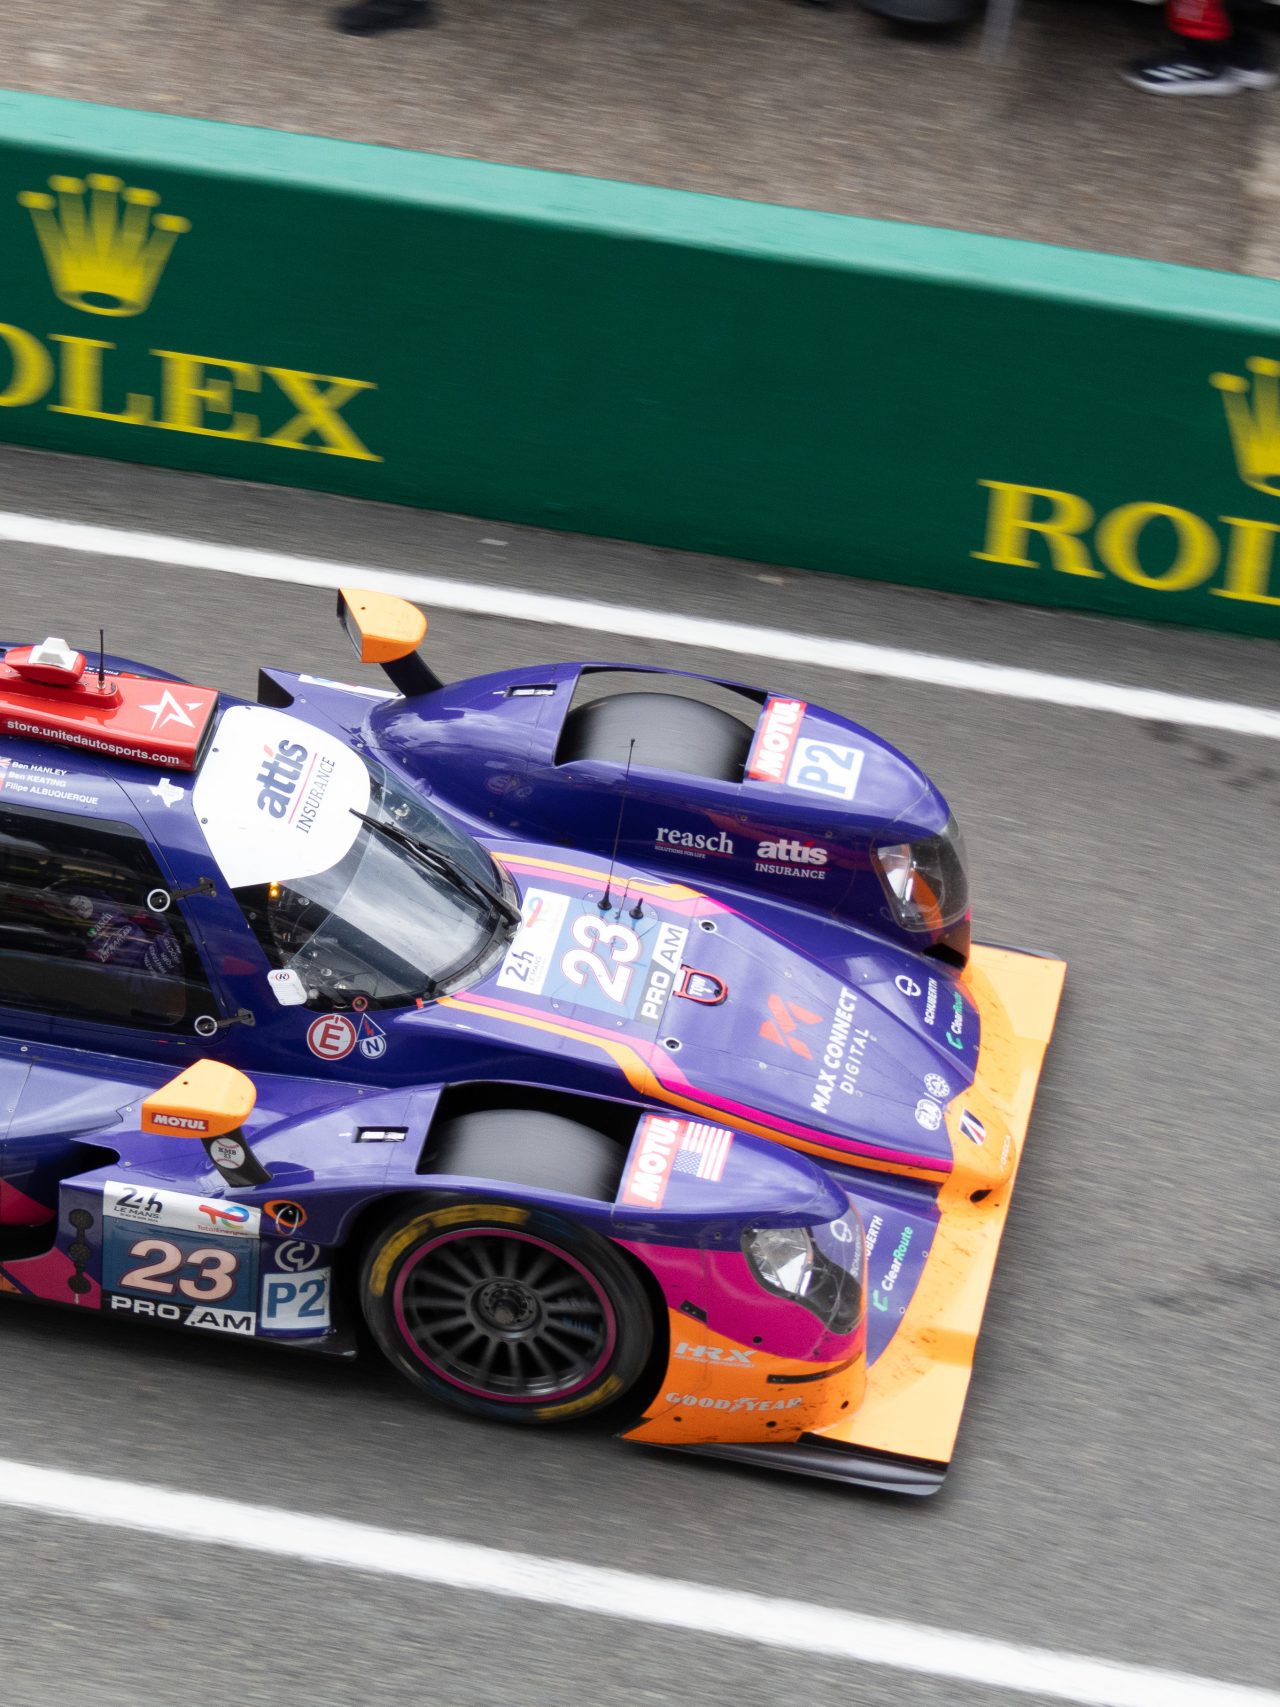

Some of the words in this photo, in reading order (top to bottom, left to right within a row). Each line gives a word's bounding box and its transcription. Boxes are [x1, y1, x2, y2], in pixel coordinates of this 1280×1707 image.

[7, 719, 179, 765] store.unitedautosports.com
[756, 700, 801, 778] MOTUL
[8, 771, 25, 780] Ben
[27, 774, 67, 788] KEATING
[12, 761, 28, 770] Ben
[31, 764, 67, 776] HANLEY
[256, 739, 308, 819] attis
[797, 743, 855, 794] P2
[5, 782, 28, 792] Filipe
[30, 787, 99, 805] ALBUQUERQUE
[295, 756, 336, 834] INSURANCE
[656, 827, 734, 854] reasch
[756, 839, 828, 865] attis
[755, 863, 826, 880] INSURANCE
[505, 951, 535, 982] 24h
[562, 914, 641, 1004] 23
[641, 972, 670, 1020] PRO
[660, 927, 683, 964] AM
[924, 976, 938, 1025] SCHUBERTH
[319, 1023, 344, 1052] E
[366, 1038, 380, 1054] N
[823, 986, 859, 1069] CONNECT
[839, 1027, 869, 1095] DIGITAL
[810, 1069, 837, 1114] MAX
[152, 1113, 206, 1130] MOTUL
[630, 1117, 679, 1203] MOTUL
[116, 1187, 164, 1213] 24h
[129, 1209, 160, 1219] MANS
[119, 1238, 239, 1302] 23
[881, 1226, 914, 1291] ClearRoute
[111, 1295, 181, 1320] PRO
[197, 1310, 253, 1332] AM
[267, 1278, 326, 1319] P2
[674, 1342, 758, 1363] HRX
[665, 1391, 802, 1413] GOODYEAR
